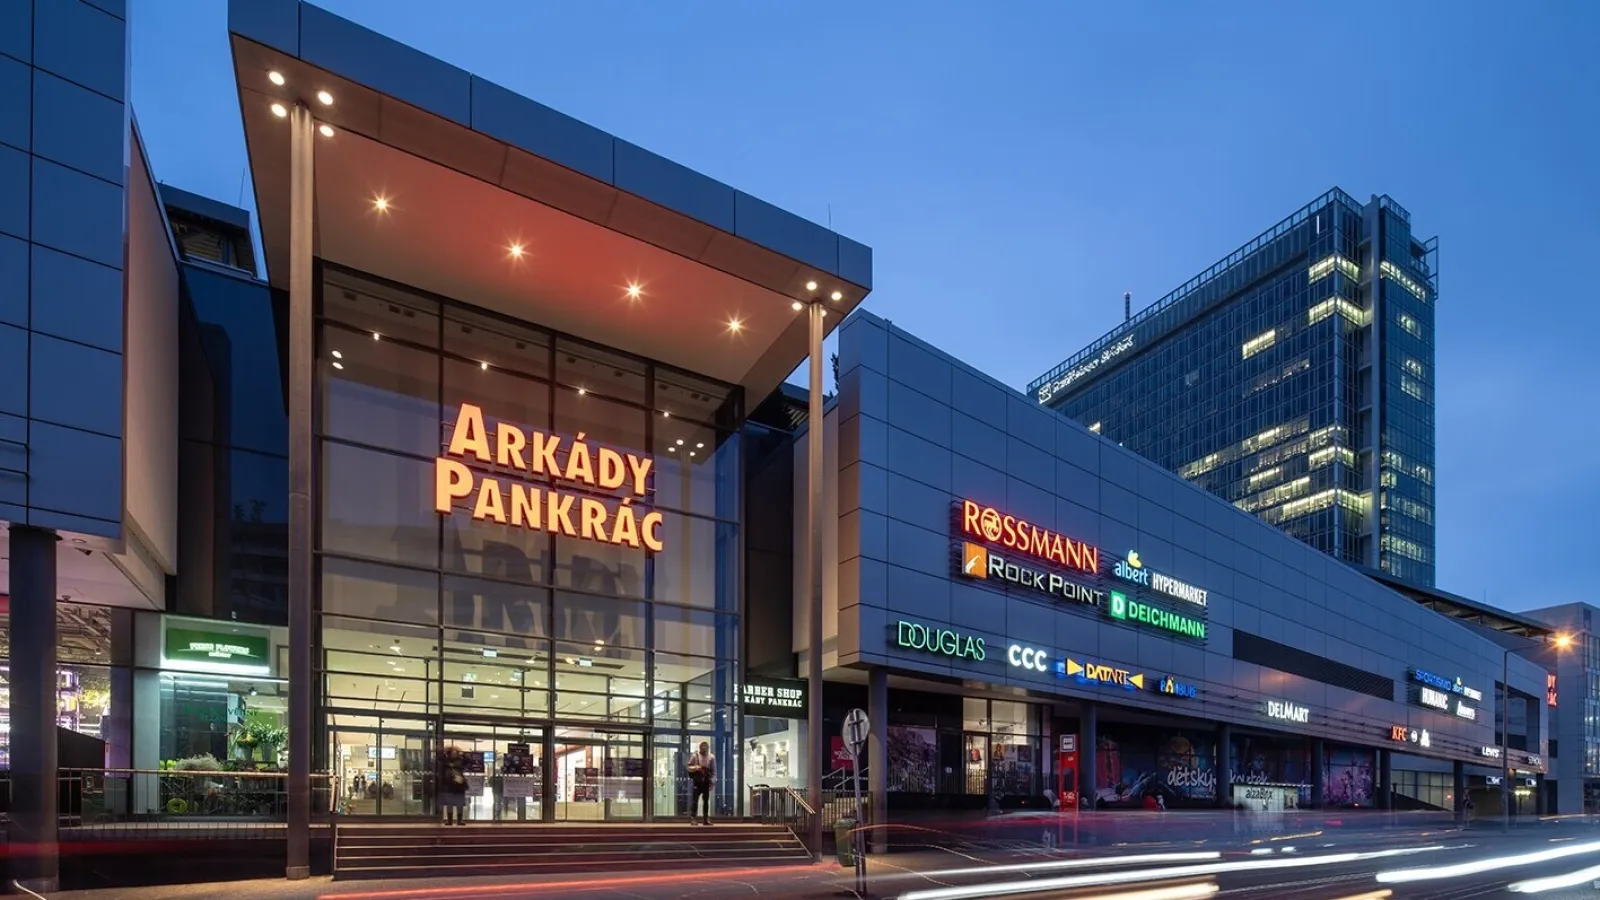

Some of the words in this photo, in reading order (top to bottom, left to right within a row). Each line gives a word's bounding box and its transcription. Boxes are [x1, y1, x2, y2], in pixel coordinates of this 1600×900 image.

[448, 402, 653, 497] ARKÁDY
[435, 456, 663, 552] PANKRÁC
[963, 499, 1099, 574] ROSSMANN
[987, 553, 1045, 591] ROCK
[1049, 573, 1104, 606] POINT
[1114, 560, 1149, 586] albert
[1152, 572, 1208, 607] HYPERMARKET
[1128, 601, 1205, 638] DEICHMANN
[897, 621, 986, 662] DOUGLAS
[1007, 644, 1048, 672] CCC
[1086, 663, 1130, 685] DATART
[733, 694, 766, 705] AKÁDY
[768, 697, 803, 708] PANKRÁC
[777, 687, 803, 700] SHOP
[1267, 700, 1309, 724] DELMART
[1391, 725, 1408, 742] KFC
[1167, 766, 1213, 791] dětský
